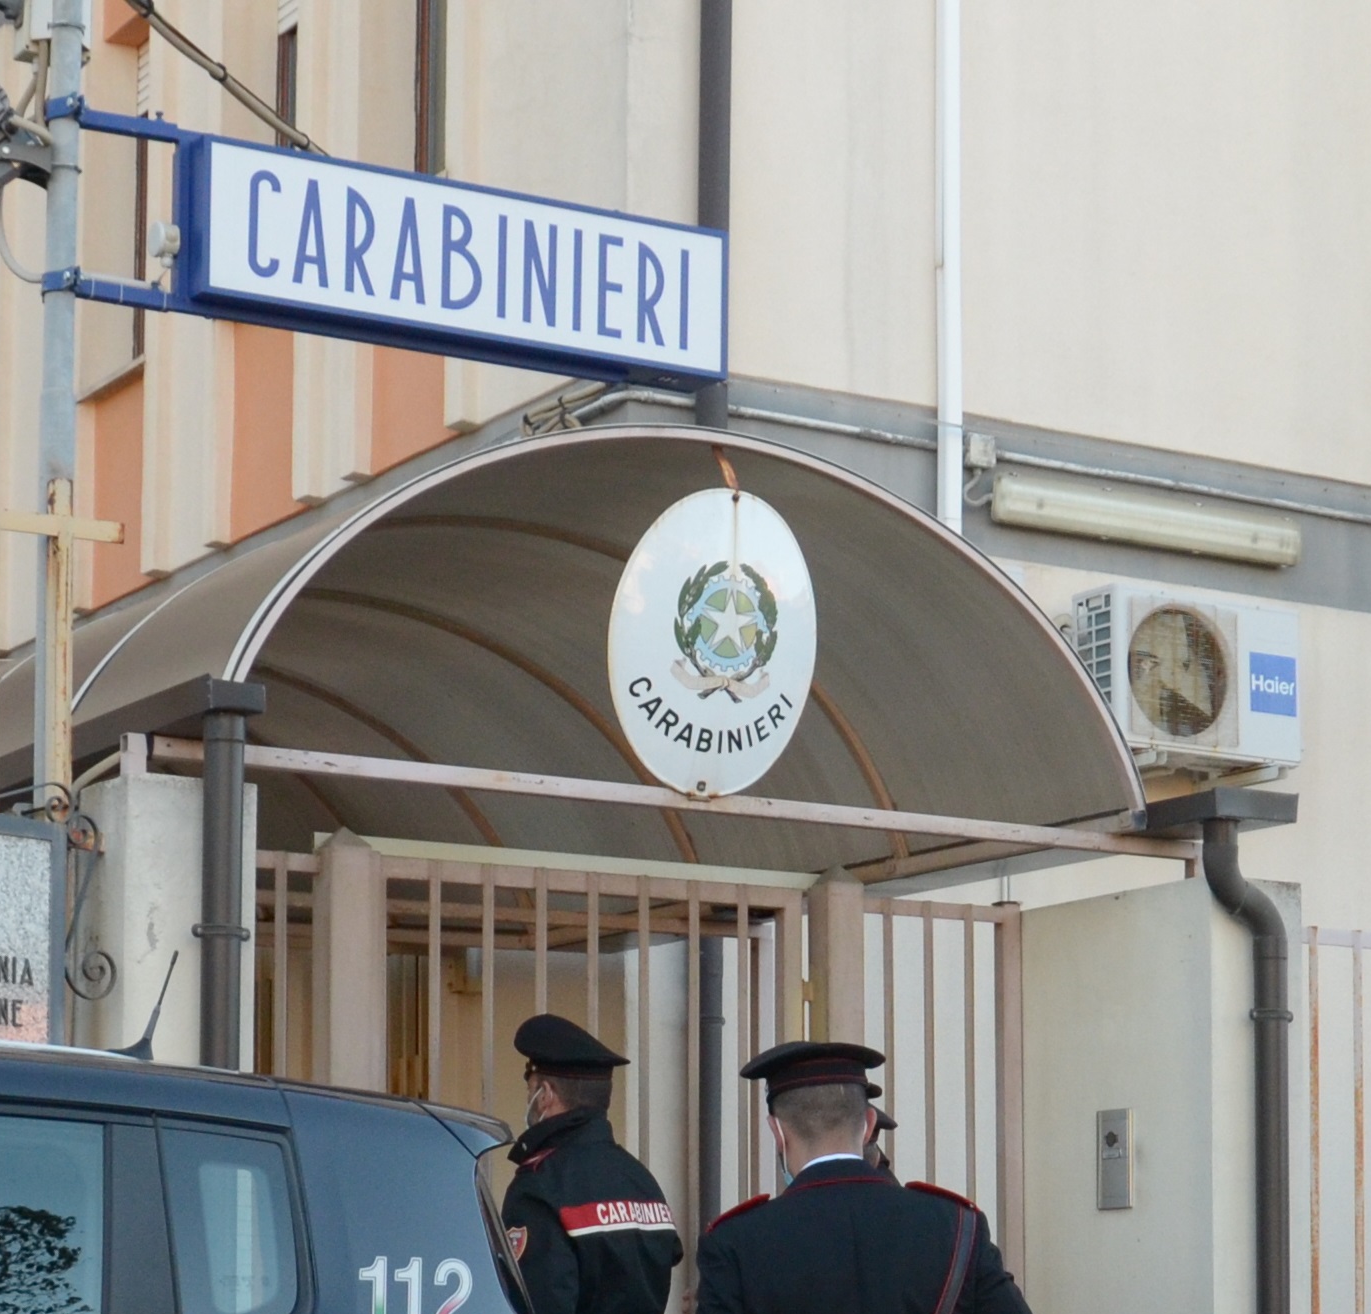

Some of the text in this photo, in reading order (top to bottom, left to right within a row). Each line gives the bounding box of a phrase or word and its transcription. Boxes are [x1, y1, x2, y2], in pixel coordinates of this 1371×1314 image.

[246, 168, 691, 352] CARABINIERI
[629, 676, 794, 754] CARABINIERI
[1251, 674, 1295, 696] Haier
